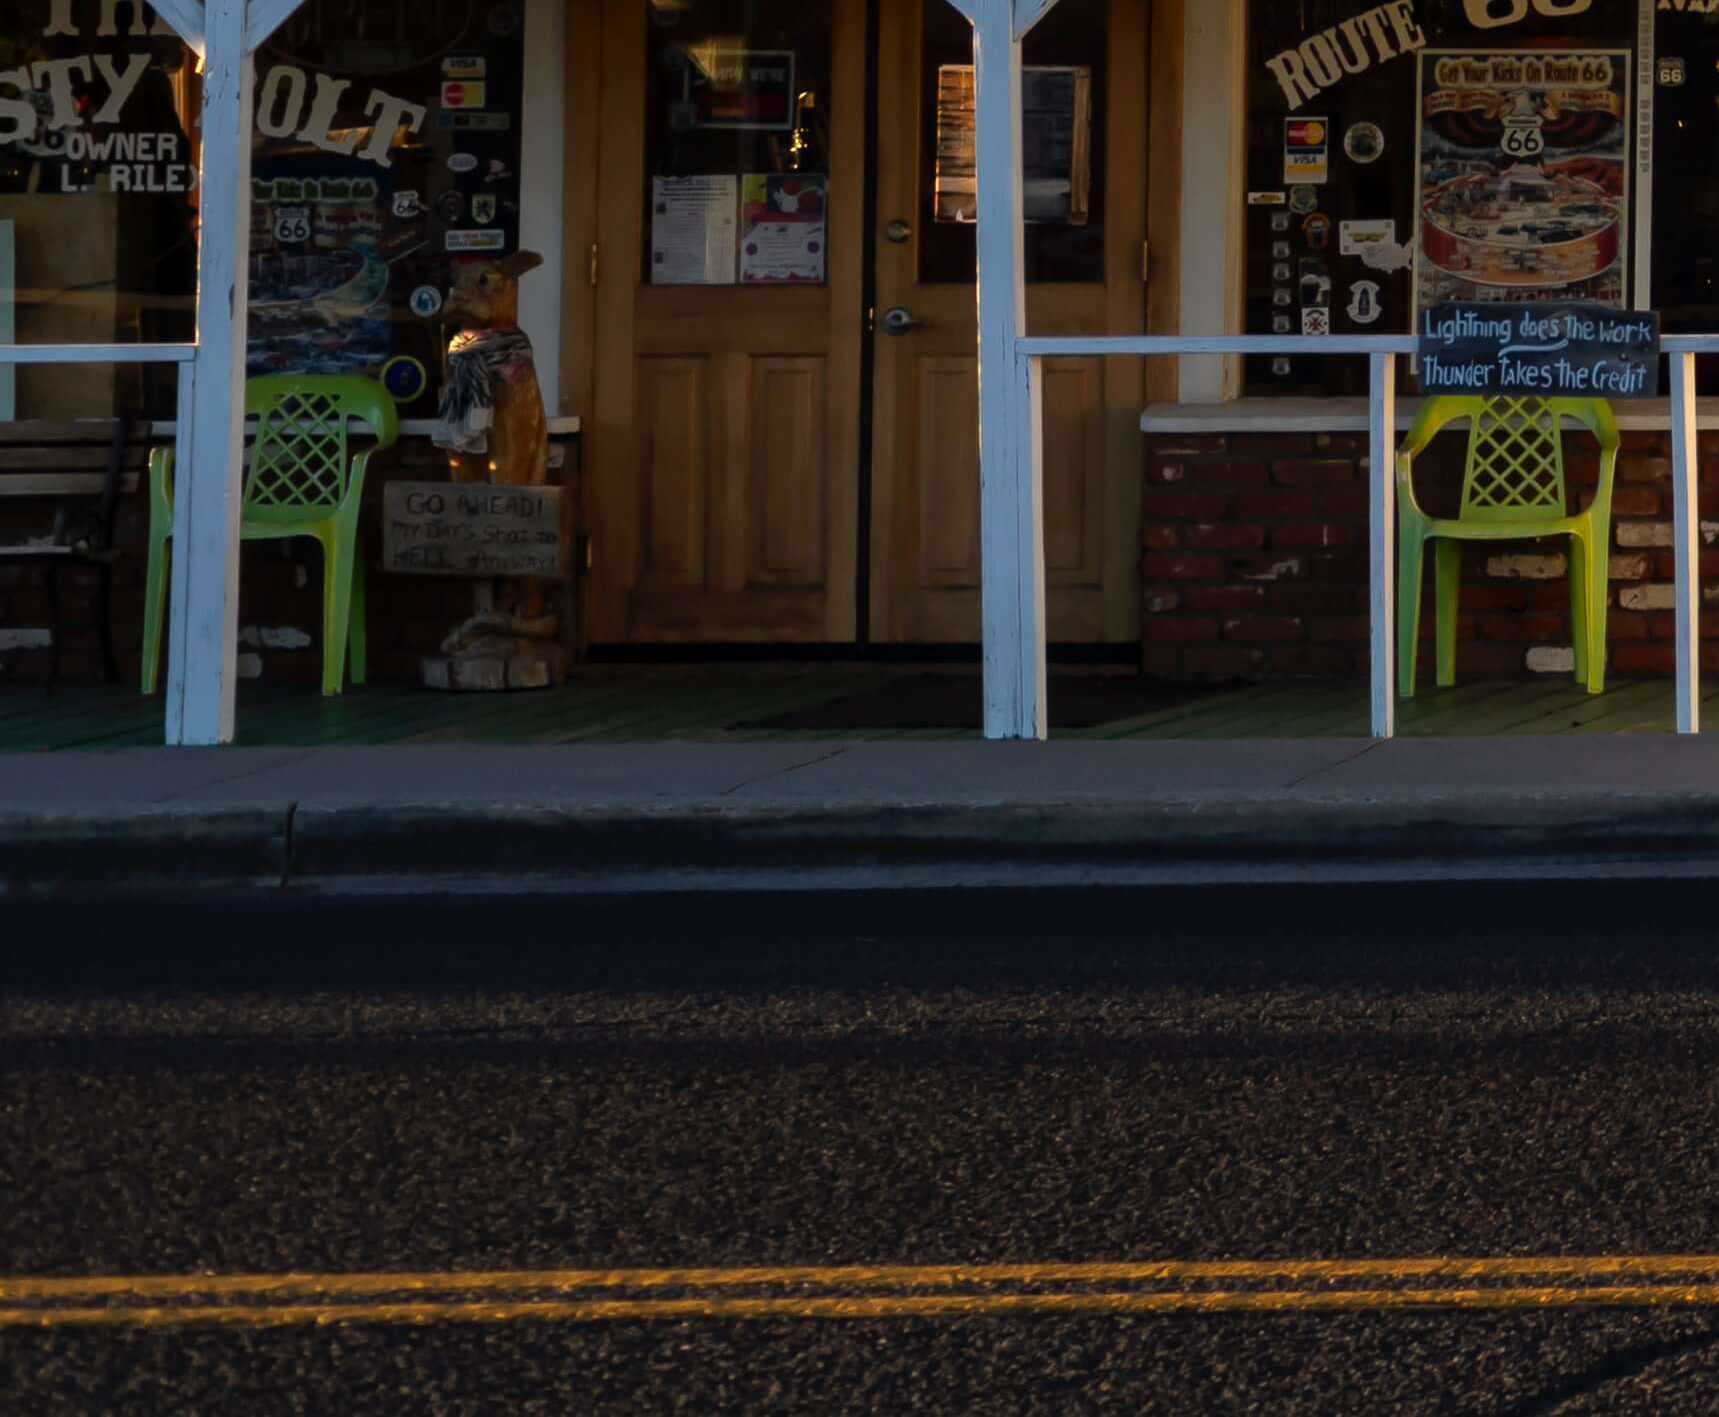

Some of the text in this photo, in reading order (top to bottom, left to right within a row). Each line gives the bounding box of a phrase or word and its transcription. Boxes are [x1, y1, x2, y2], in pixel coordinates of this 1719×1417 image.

[1462, 63, 1488, 81] Your
[1492, 63, 1522, 81] Kicks
[1545, 63, 1578, 81] Route
[1582, 63, 1608, 81] 66
[1660, 69, 1682, 83] 66
[200, 65, 427, 167] OLT
[67, 132, 178, 161] OWNER
[1506, 130, 1539, 152] 66
[279, 219, 307, 239] 66
[1425, 309, 1512, 345] Lightning
[1519, 310, 1560, 341] does
[406, 492, 445, 515] GO
